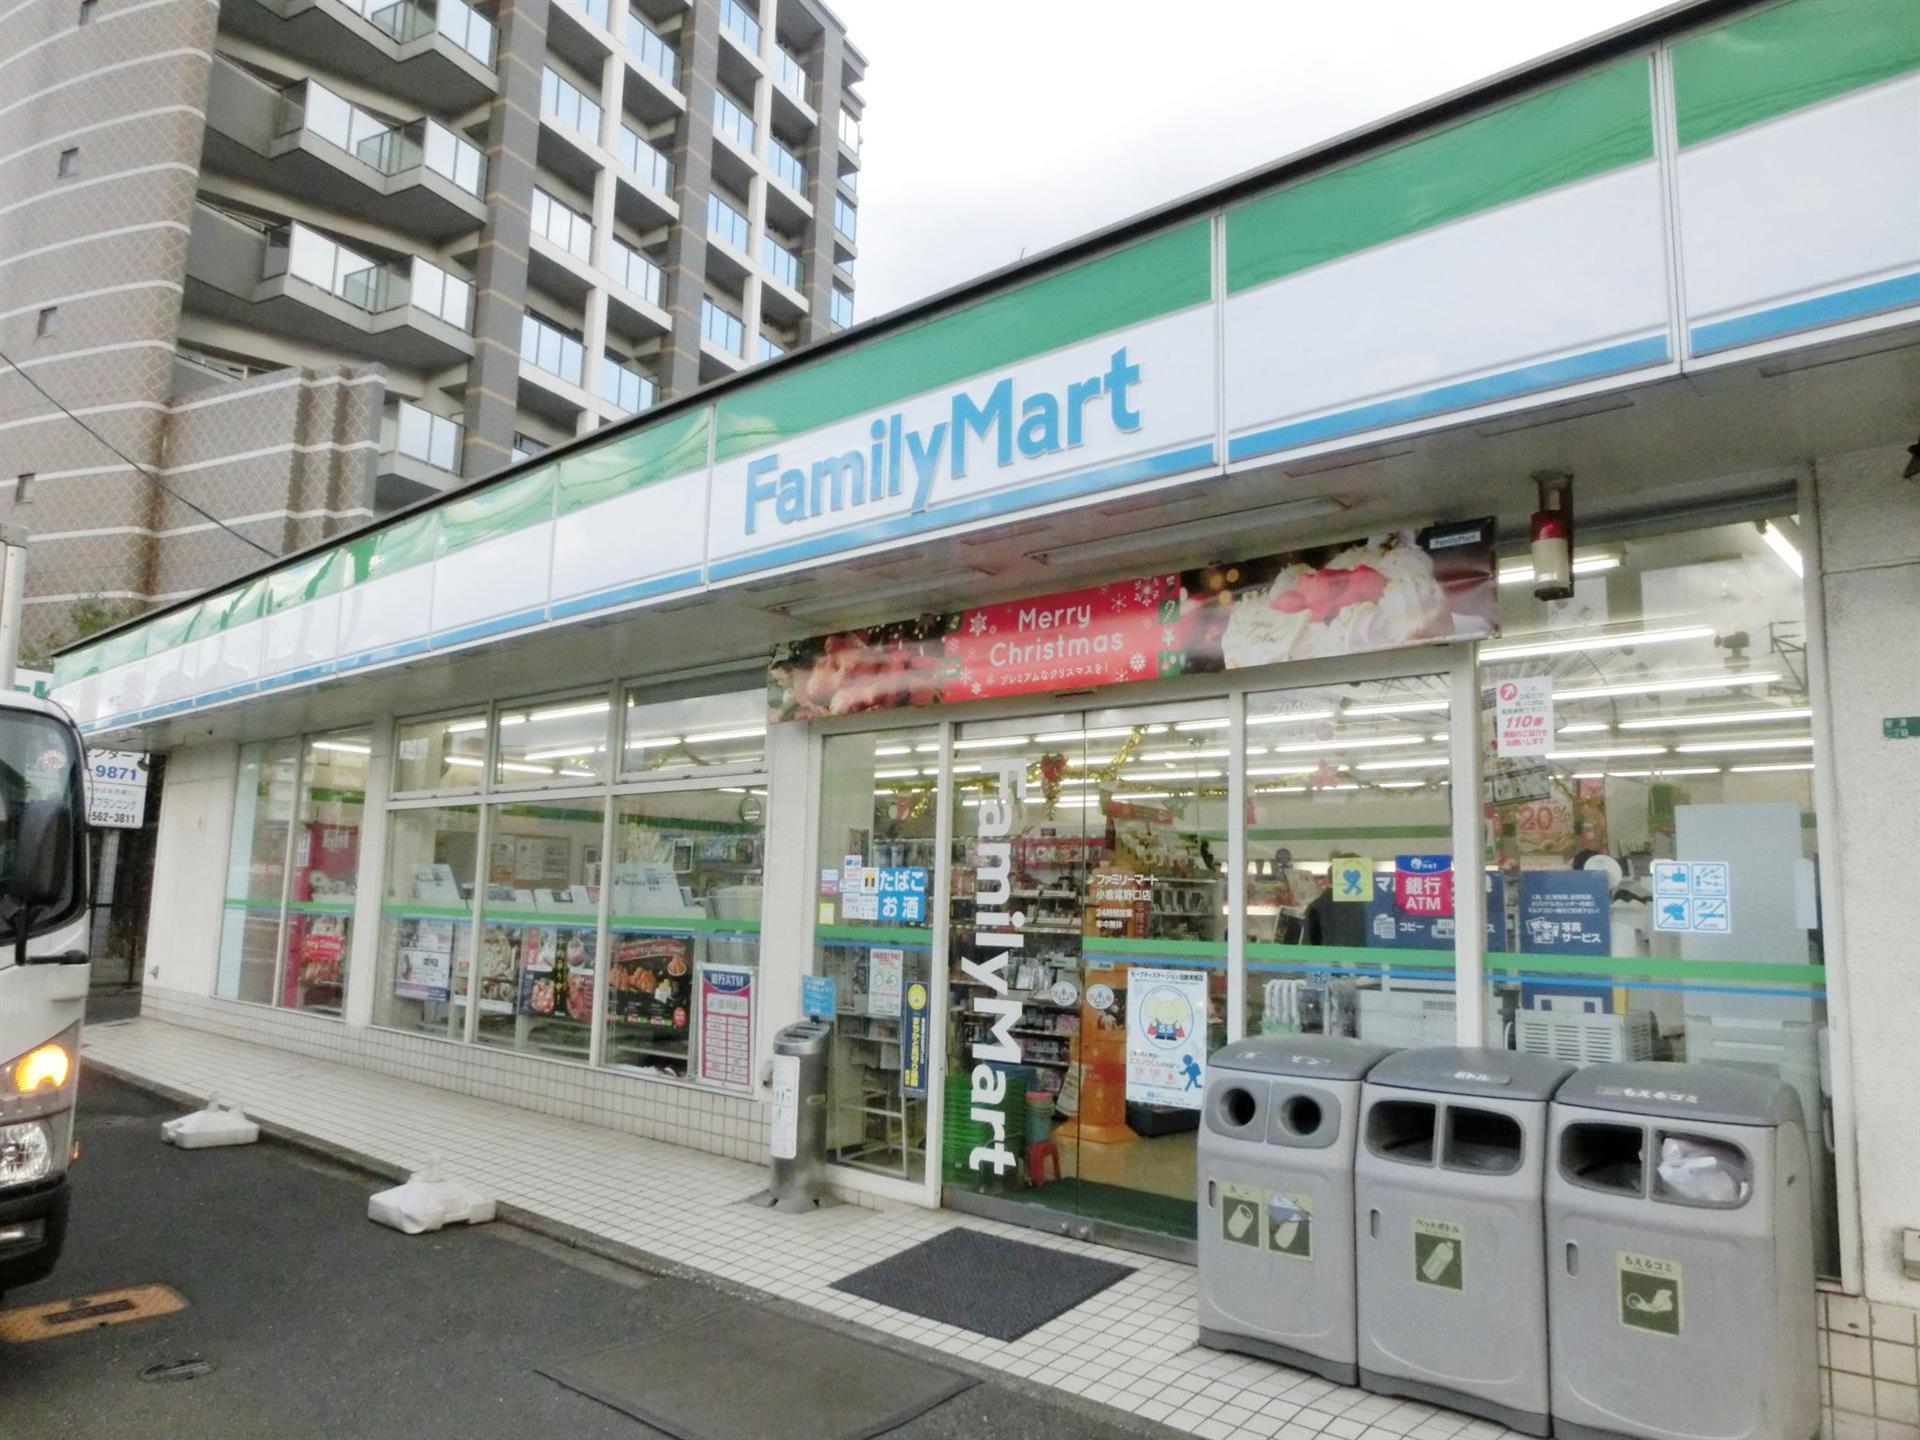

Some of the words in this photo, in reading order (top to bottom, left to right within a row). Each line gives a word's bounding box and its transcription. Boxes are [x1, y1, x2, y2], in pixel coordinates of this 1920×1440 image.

[745, 347, 1142, 535] FamilyMart
[1018, 605, 1091, 632] Merry
[990, 632, 1124, 667] Christmas
[880, 870, 925, 892] たばこ
[1096, 874, 1159, 887] ファミリーマート
[1406, 877, 1442, 895] 銀行
[882, 896, 920, 919] お酒
[1406, 897, 1441, 911] ATM
[1400, 922, 1424, 931] コピー
[1561, 932, 1602, 944] サービス
[961, 757, 1028, 1176] FamilyMart
[1622, 1087, 1699, 1104] もえるゴミ
[1624, 1255, 1673, 1274] もえるゴミ
